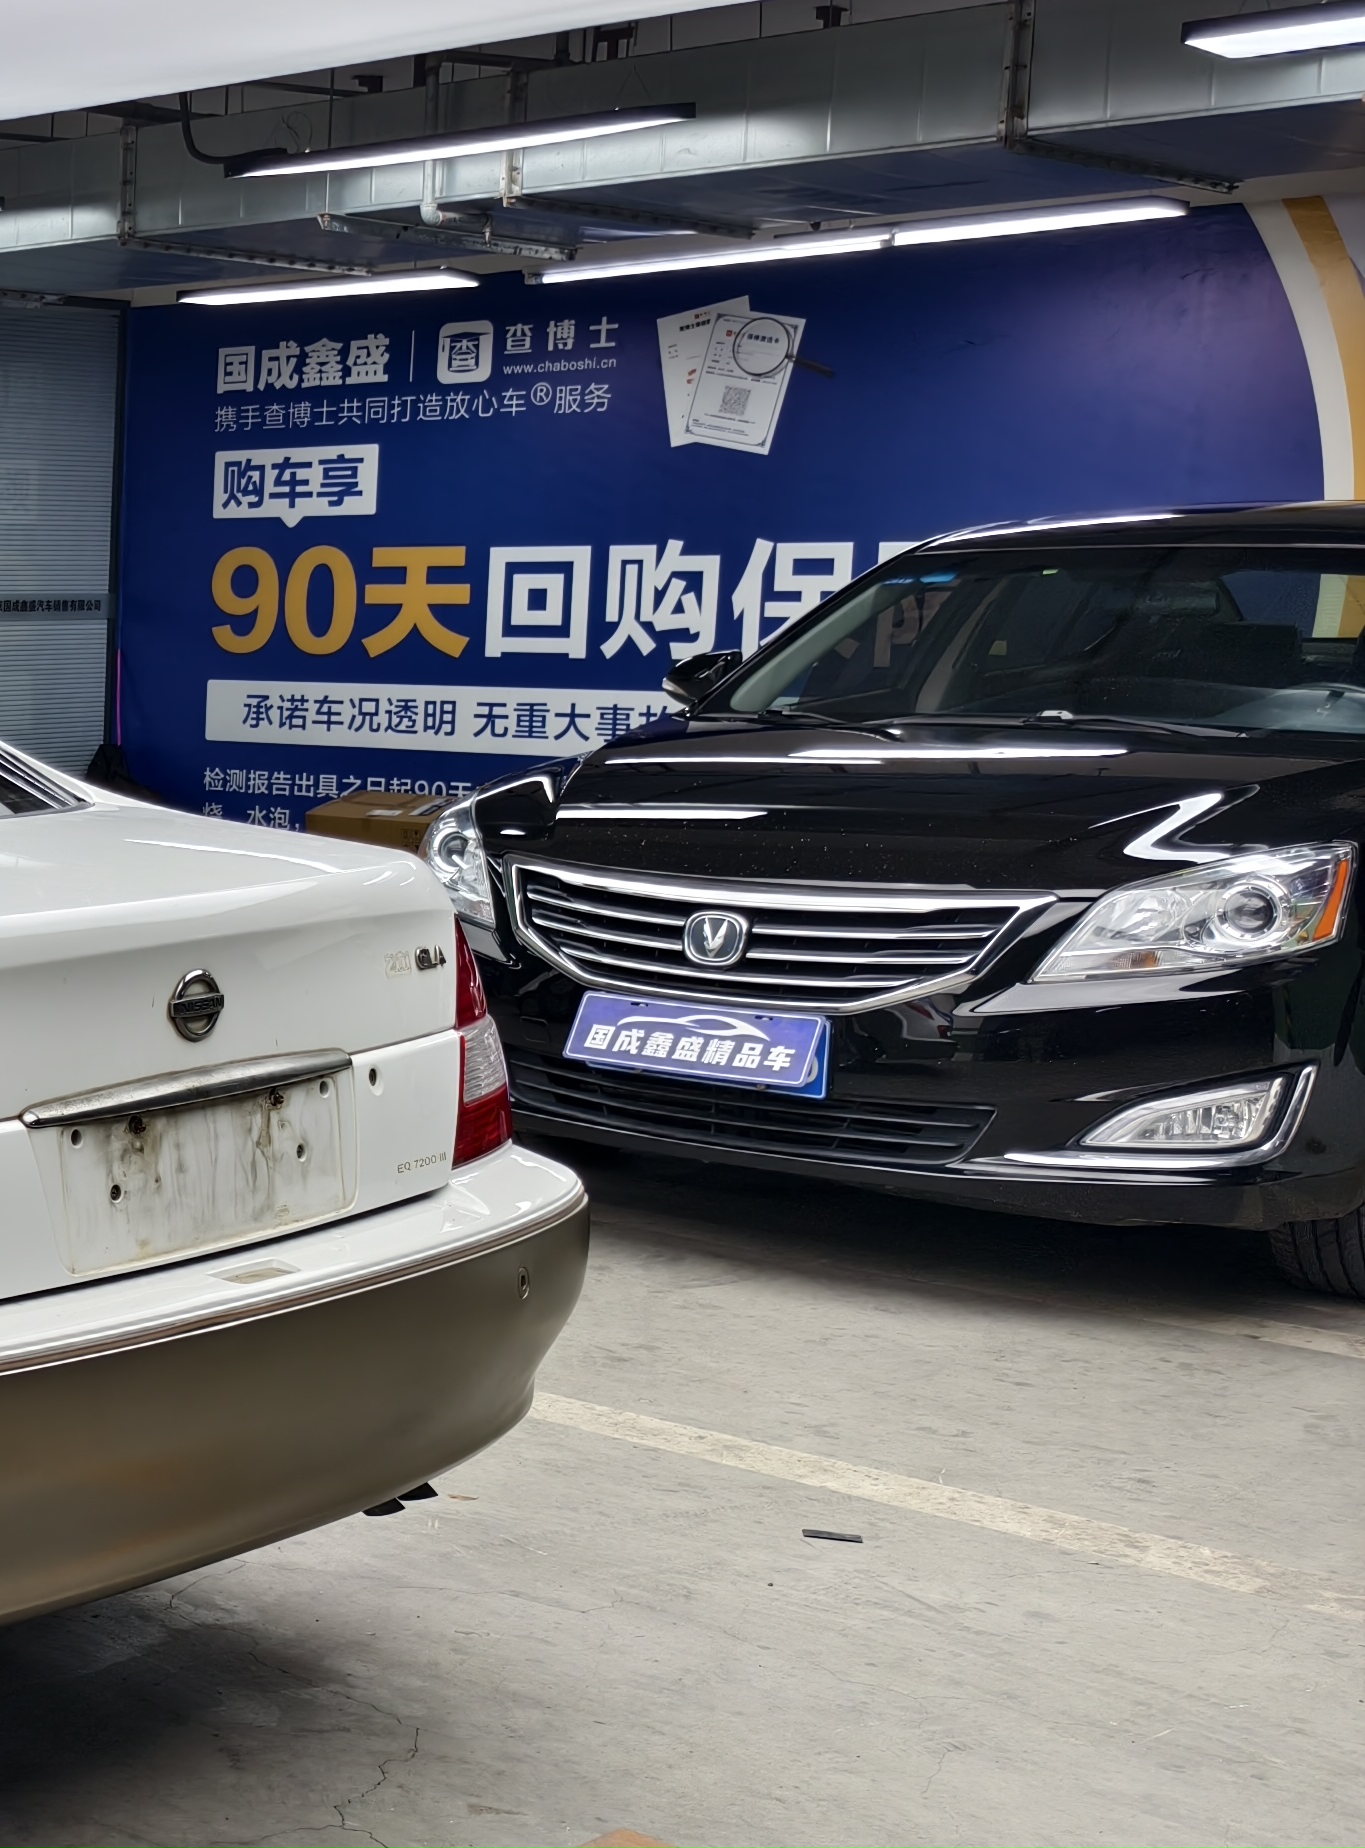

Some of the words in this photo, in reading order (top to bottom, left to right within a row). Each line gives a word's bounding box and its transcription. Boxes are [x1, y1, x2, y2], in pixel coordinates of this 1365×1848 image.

[216, 333, 390, 394] 国成鑫盛
[503, 316, 619, 354] 查博士
[503, 356, 617, 375] www.chaboshi.cn
[222, 454, 365, 510] 购车享
[211, 538, 920, 662] 90天回购保
[241, 694, 457, 738] 承诺车况透明
[583, 1022, 796, 1072] 国成鑫盛精品车
[414, 1154, 437, 1169] 7200
